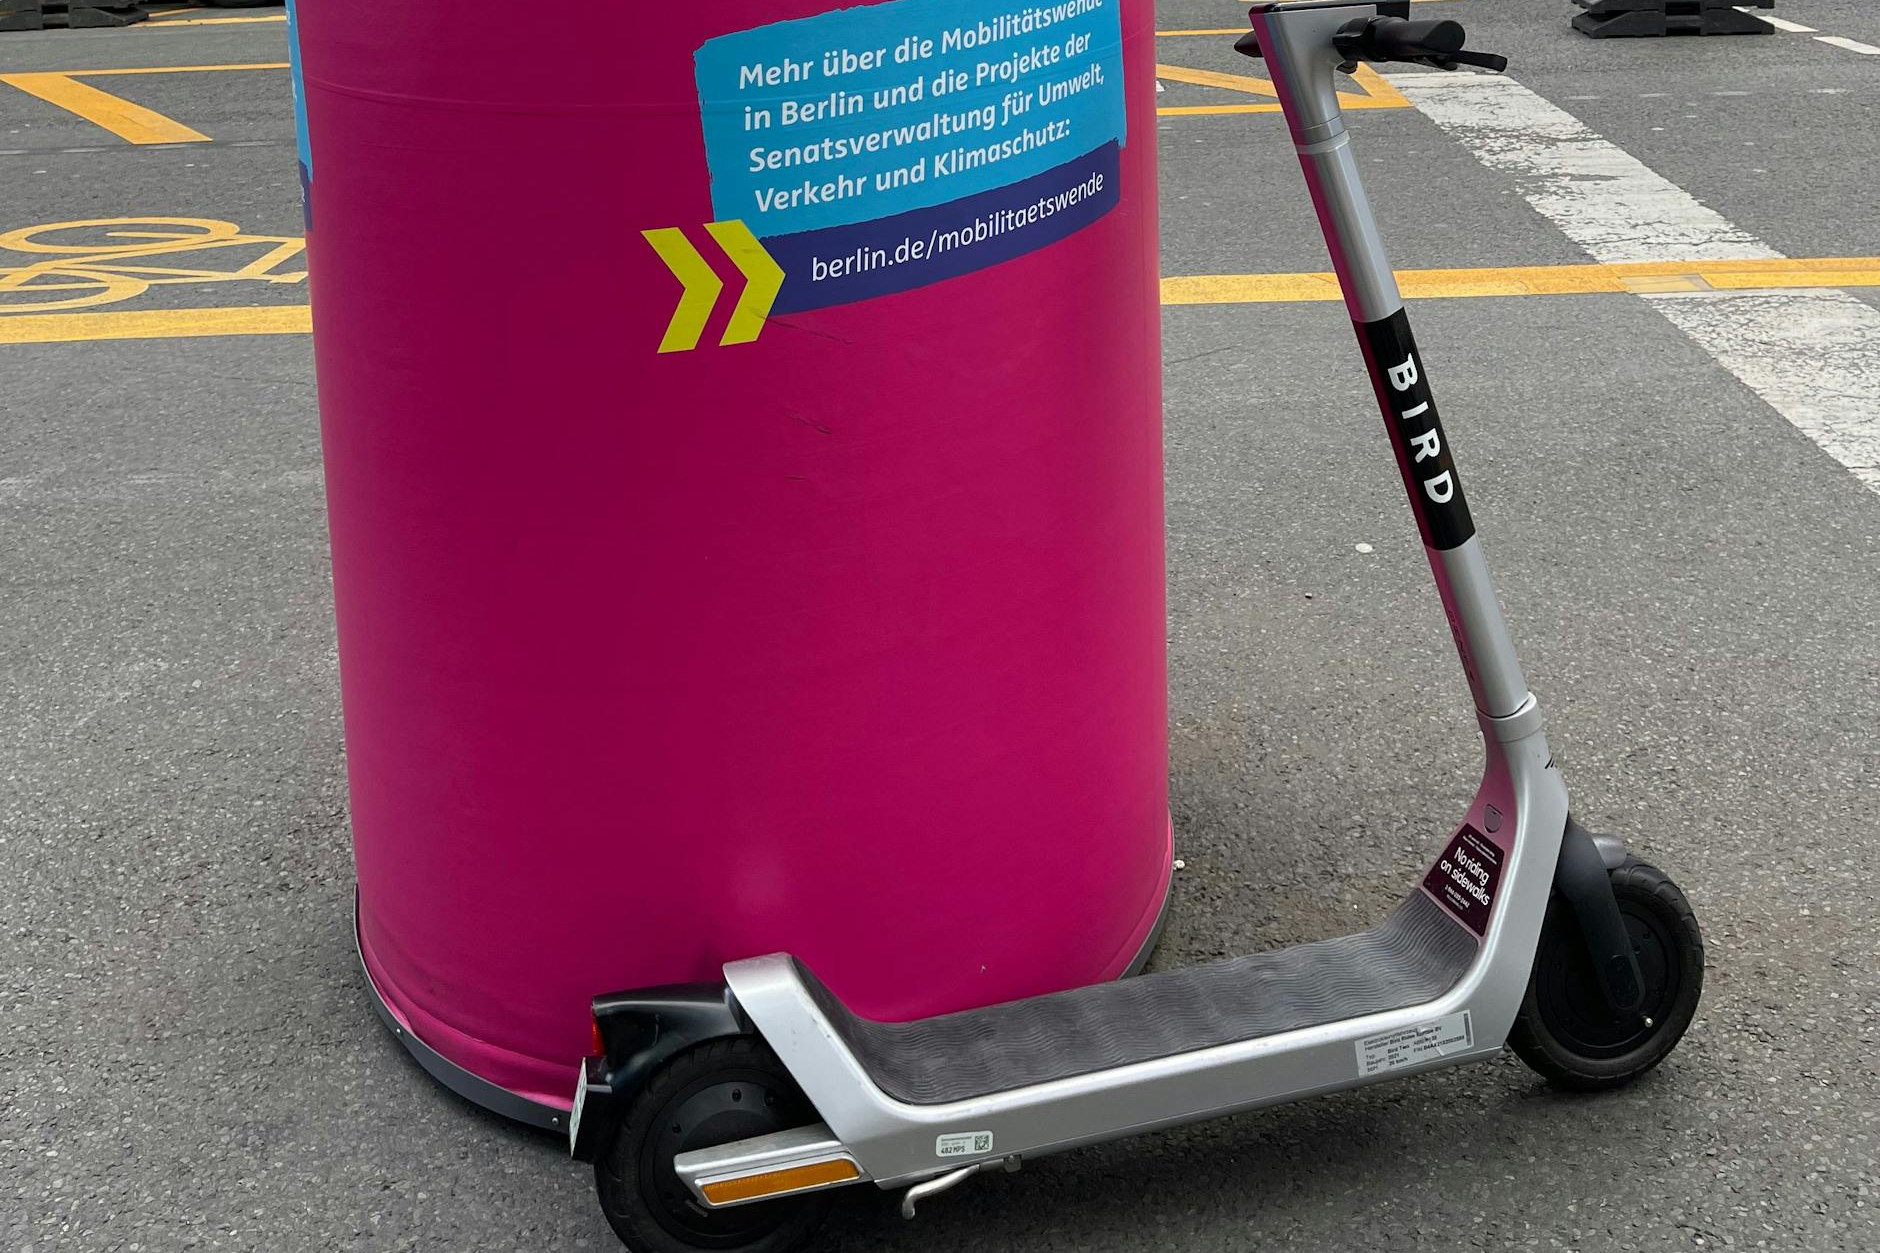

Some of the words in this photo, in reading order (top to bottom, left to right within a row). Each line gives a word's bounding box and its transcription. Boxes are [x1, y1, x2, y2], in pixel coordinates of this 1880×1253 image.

[740, 58, 813, 89] Mehr
[823, 48, 886, 76] über
[895, 36, 933, 63] die
[745, 106, 770, 130] in
[782, 91, 863, 125] Berlin
[874, 76, 923, 109] und
[932, 69, 968, 96] die
[976, 45, 1060, 86] Projekte
[1065, 33, 1090, 58] der
[750, 105, 995, 172] Senatsverwaltung
[1002, 90, 1033, 126] für
[1039, 64, 1104, 106] Umwelt,
[755, 175, 867, 212] Verkehr
[876, 158, 925, 191] und
[934, 119, 1070, 178] Klimaschutz:
[813, 172, 1103, 281] berlin.de/mobilitaetswende
[1387, 352, 1454, 504] BIRD
[1440, 859, 1452, 874] on
[1451, 867, 1491, 906] sidewalks
[1453, 846, 1467, 865] No
[1466, 857, 1490, 886] riding
